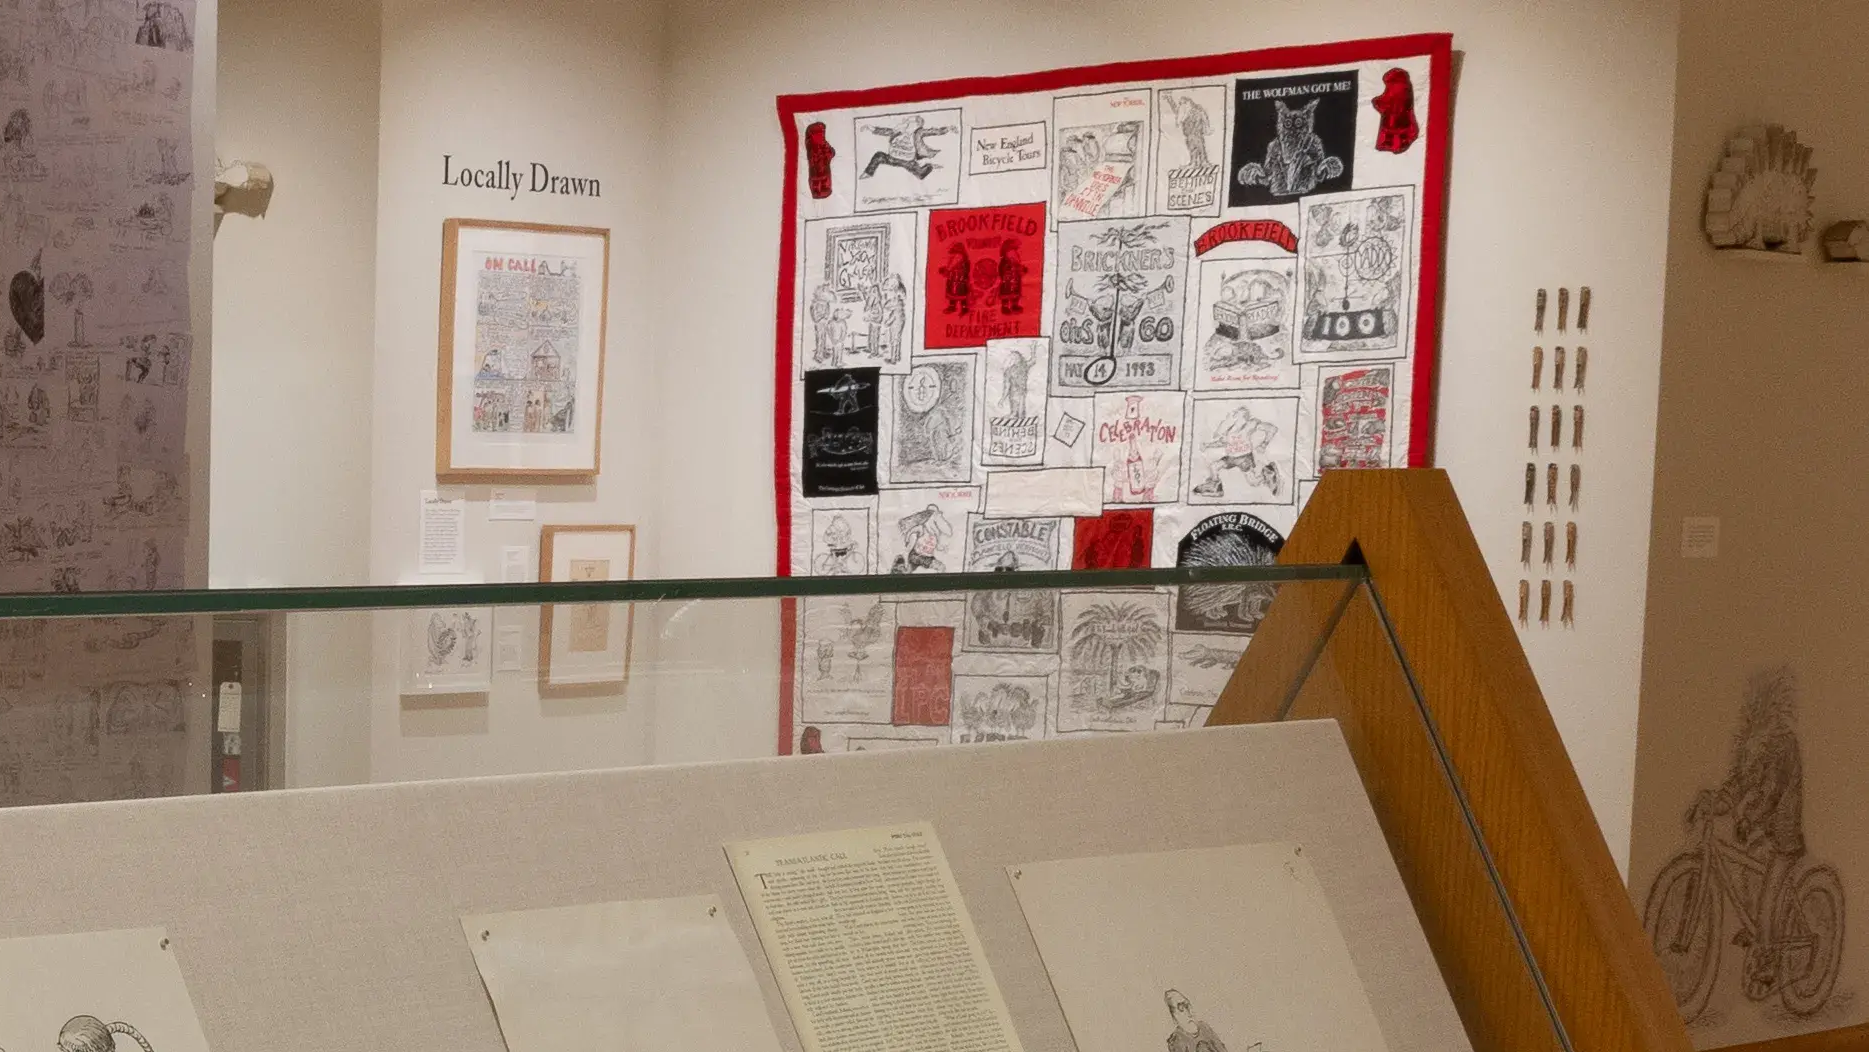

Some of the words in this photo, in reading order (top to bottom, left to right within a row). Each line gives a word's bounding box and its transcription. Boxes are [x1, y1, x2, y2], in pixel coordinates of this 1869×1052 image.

[1242, 91, 1261, 100] THE
[1263, 86, 1310, 99] WOLFMAN
[1311, 83, 1331, 93] GOT
[1332, 81, 1353, 91] ME!
[976, 139, 997, 151] New
[1000, 133, 1034, 151] England
[982, 153, 1014, 167] Bicycle
[1017, 149, 1041, 162] Tours
[442, 154, 524, 200] Locally
[529, 162, 601, 197] Drawn
[1170, 176, 1214, 189] BEHIND
[1170, 191, 1212, 206] SCENES
[935, 212, 1038, 242] BROOKFIELD
[945, 321, 1022, 338] DEPARTMENT
[1139, 316, 1174, 343] 60
[1125, 361, 1156, 377] 1993
[975, 521, 1048, 544] CONSTABLE
[1191, 514, 1238, 541] FLOATING
[1239, 514, 1279, 543] BRIDGE
